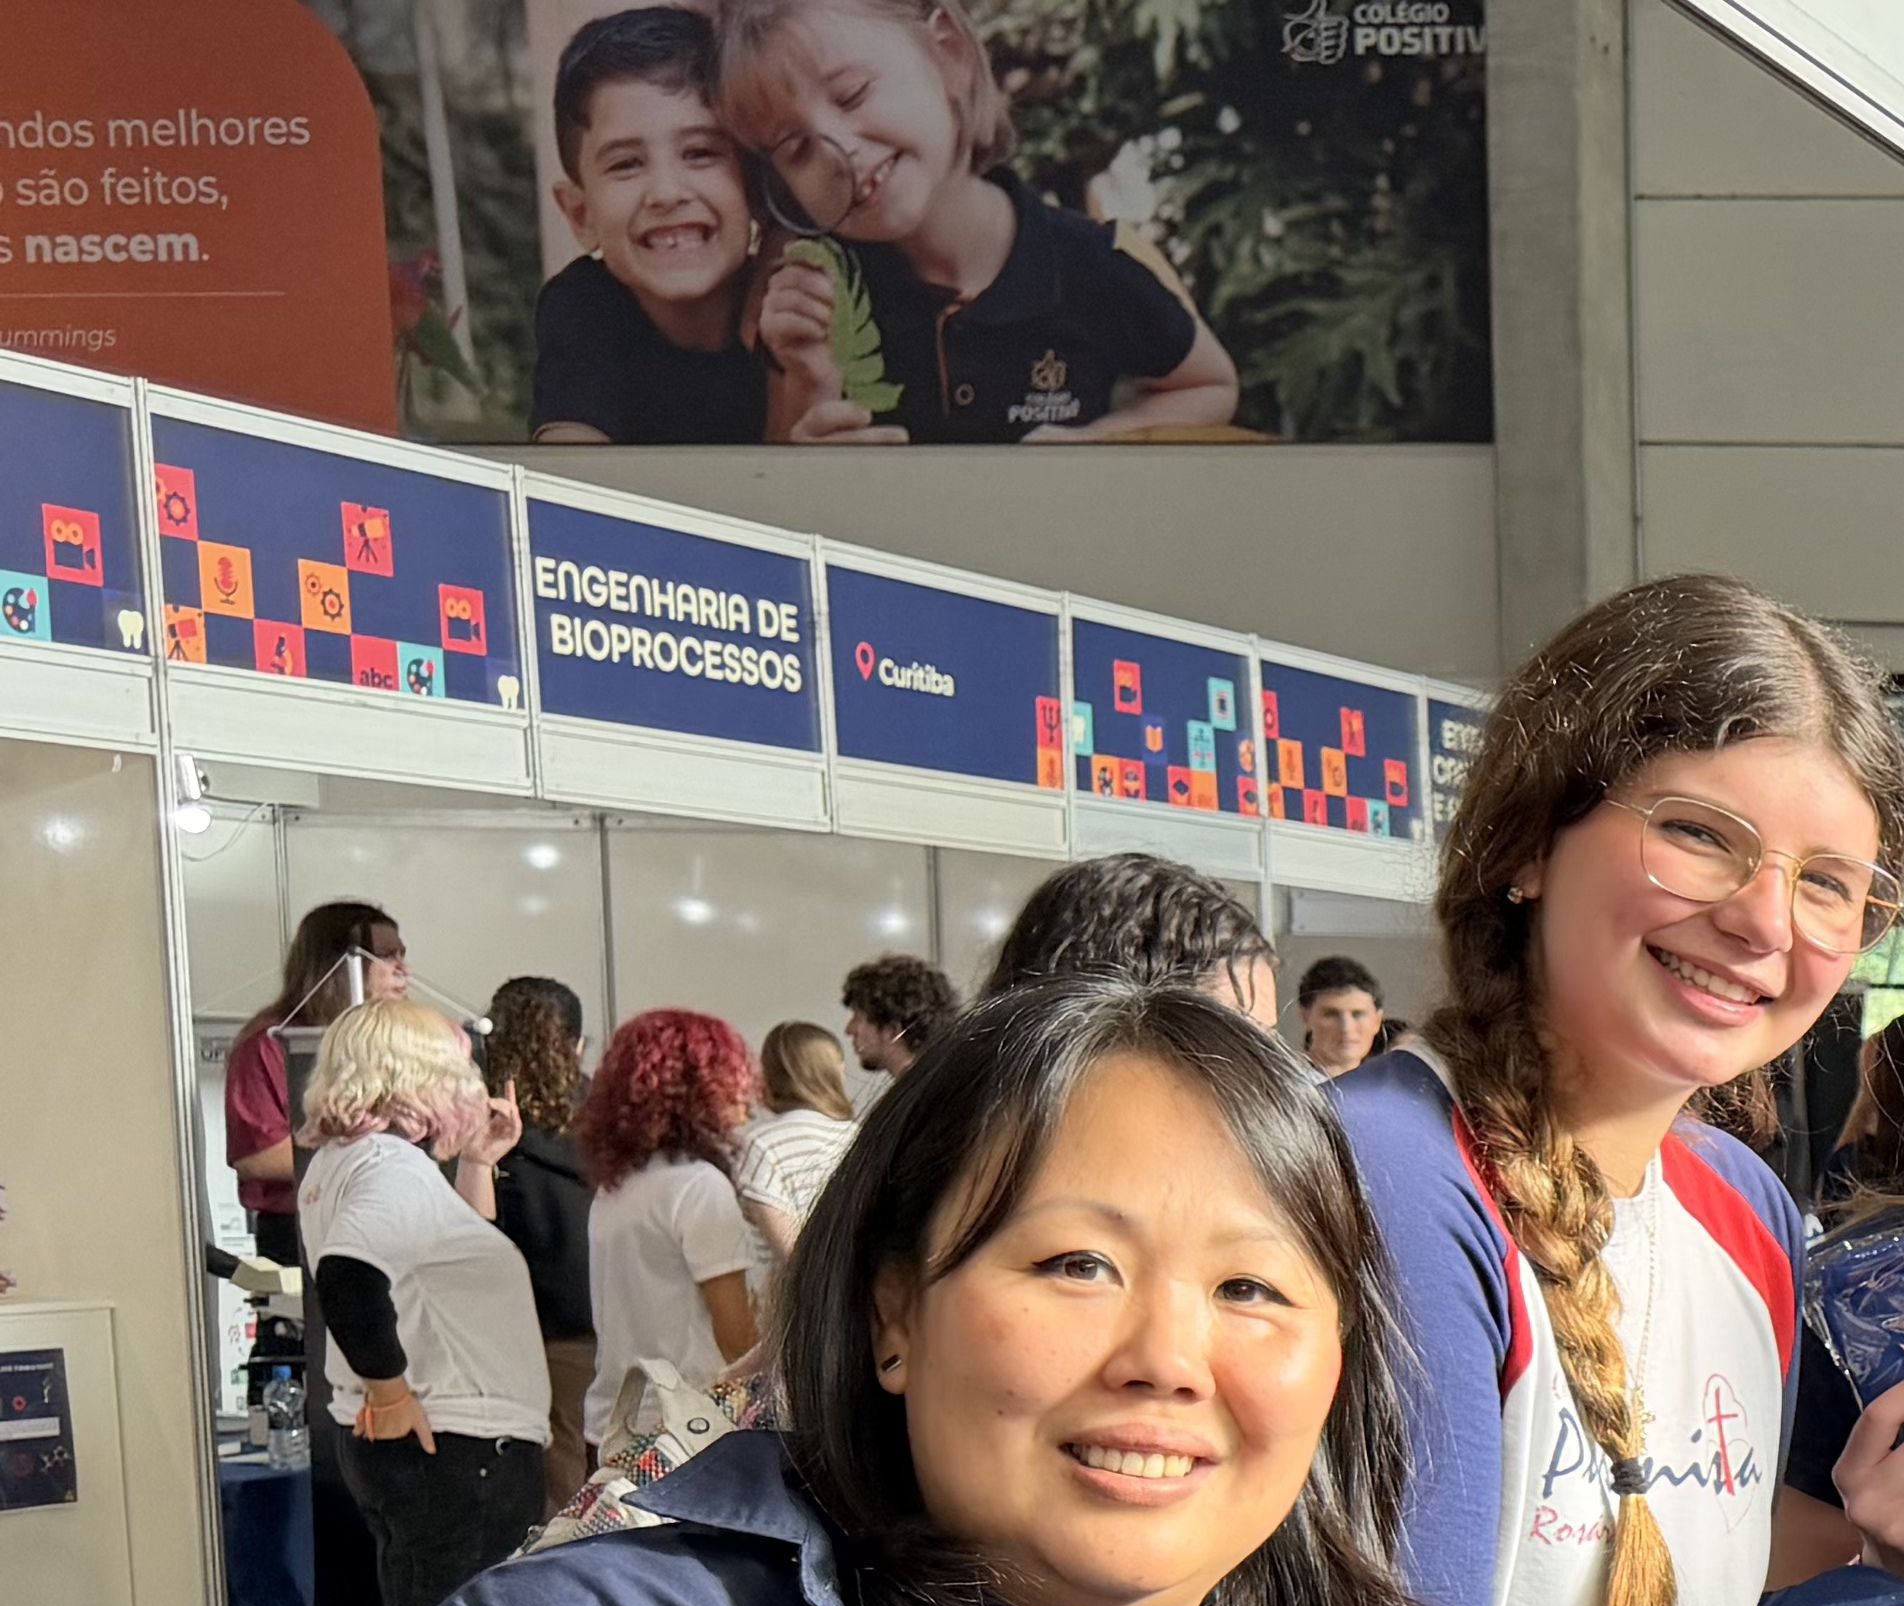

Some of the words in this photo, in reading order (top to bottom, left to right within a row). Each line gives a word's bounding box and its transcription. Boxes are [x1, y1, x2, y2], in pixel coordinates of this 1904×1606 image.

[107, 109, 311, 147] melhores
[16, 168, 89, 206] são
[101, 166, 228, 210] feitos,
[25, 232, 210, 263] nascem.
[535, 556, 750, 634] ENGENHARIA
[758, 599, 800, 643] DE
[550, 613, 802, 693] BIOPROCESSOS
[879, 657, 954, 698] Curitiba
